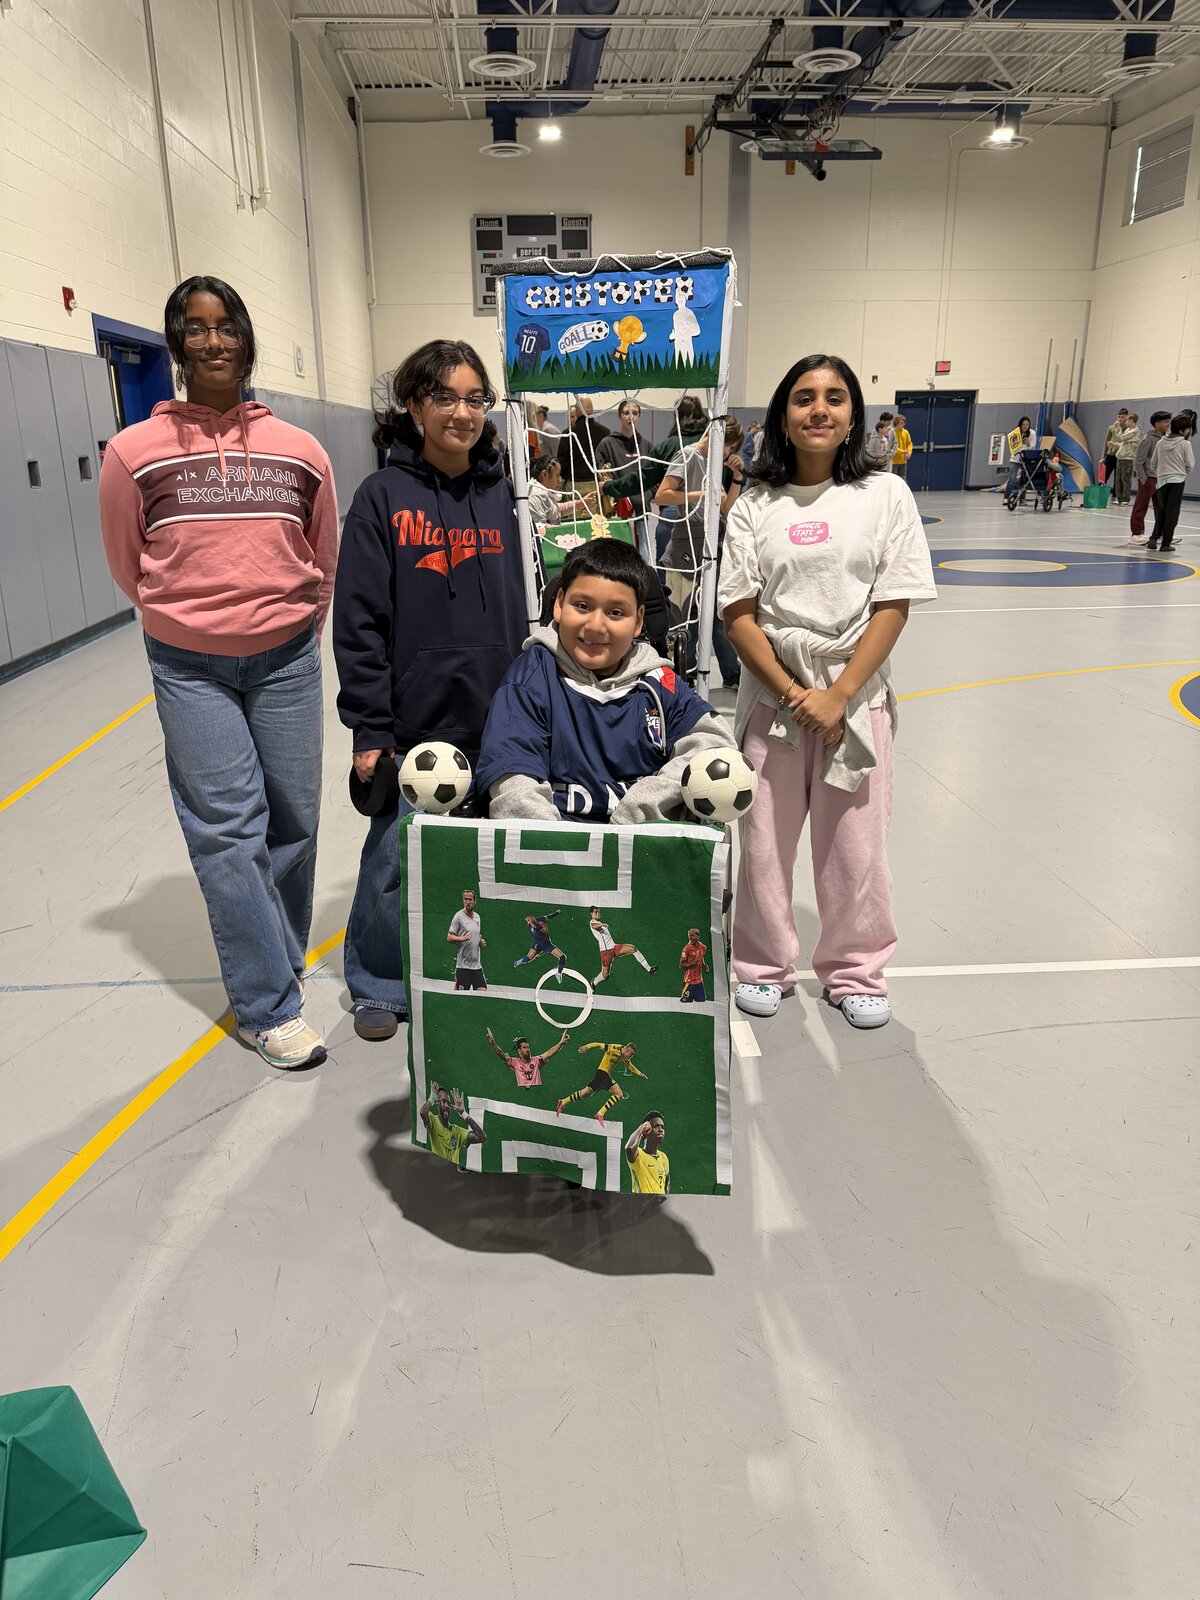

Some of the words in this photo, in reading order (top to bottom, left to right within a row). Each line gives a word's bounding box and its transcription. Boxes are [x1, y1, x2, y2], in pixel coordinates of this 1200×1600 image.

[479, 219, 499, 227] Home
[563, 216, 587, 227] Guests
[520, 248, 543, 257] period
[525, 276, 694, 309] CRISTOFER
[520, 334, 537, 354] 10
[205, 465, 299, 488] ARMANI
[177, 486, 300, 507] EXCHANGE
[391, 509, 504, 554] Niagara
[791, 529, 815, 537] STATE
